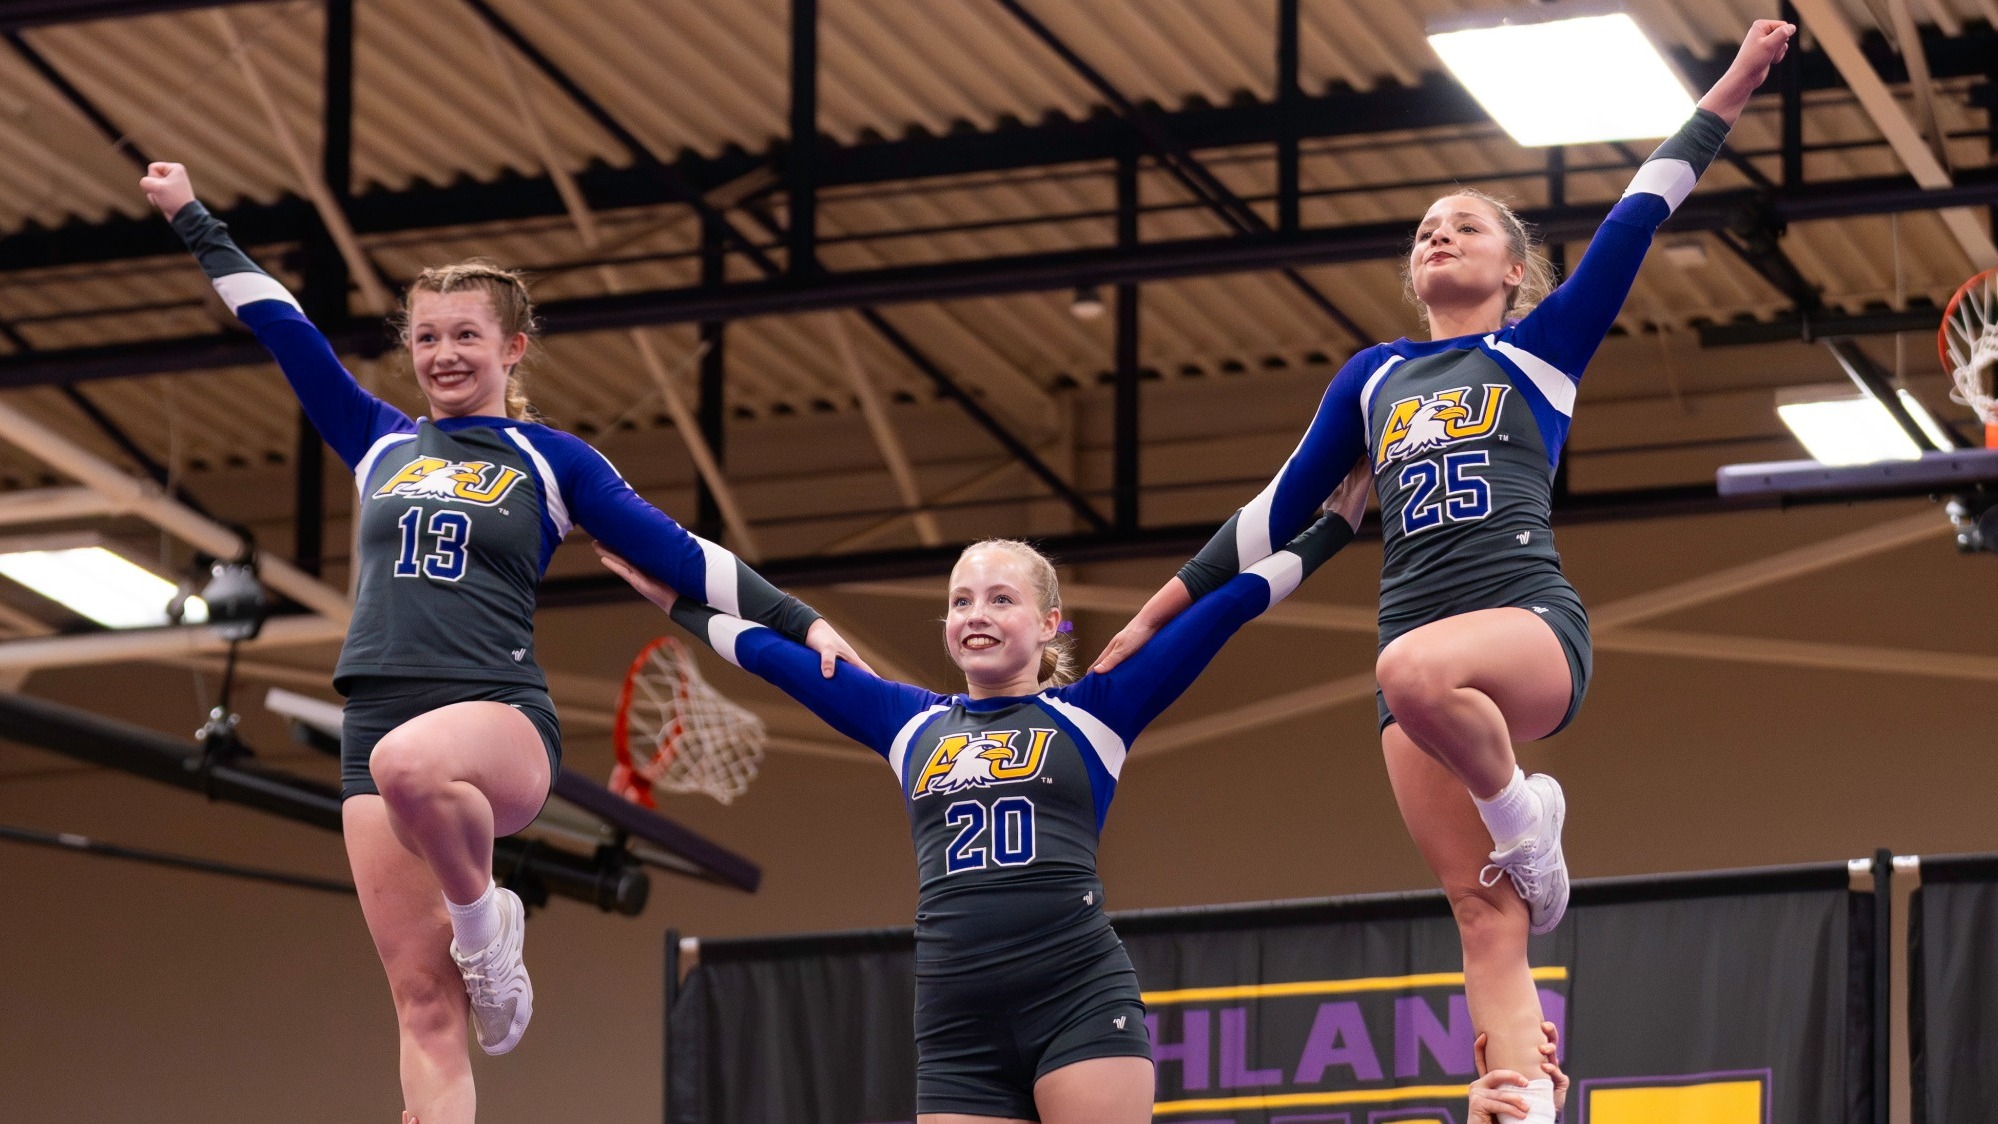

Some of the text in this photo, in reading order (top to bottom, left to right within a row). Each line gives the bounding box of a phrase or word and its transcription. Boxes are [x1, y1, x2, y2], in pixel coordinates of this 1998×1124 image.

[1375, 384, 1512, 474] AU
[372, 455, 527, 507] AU
[1399, 450, 1492, 537] 25
[394, 506, 472, 582] 13
[911, 728, 1058, 800] AU
[945, 796, 1036, 875] 20
